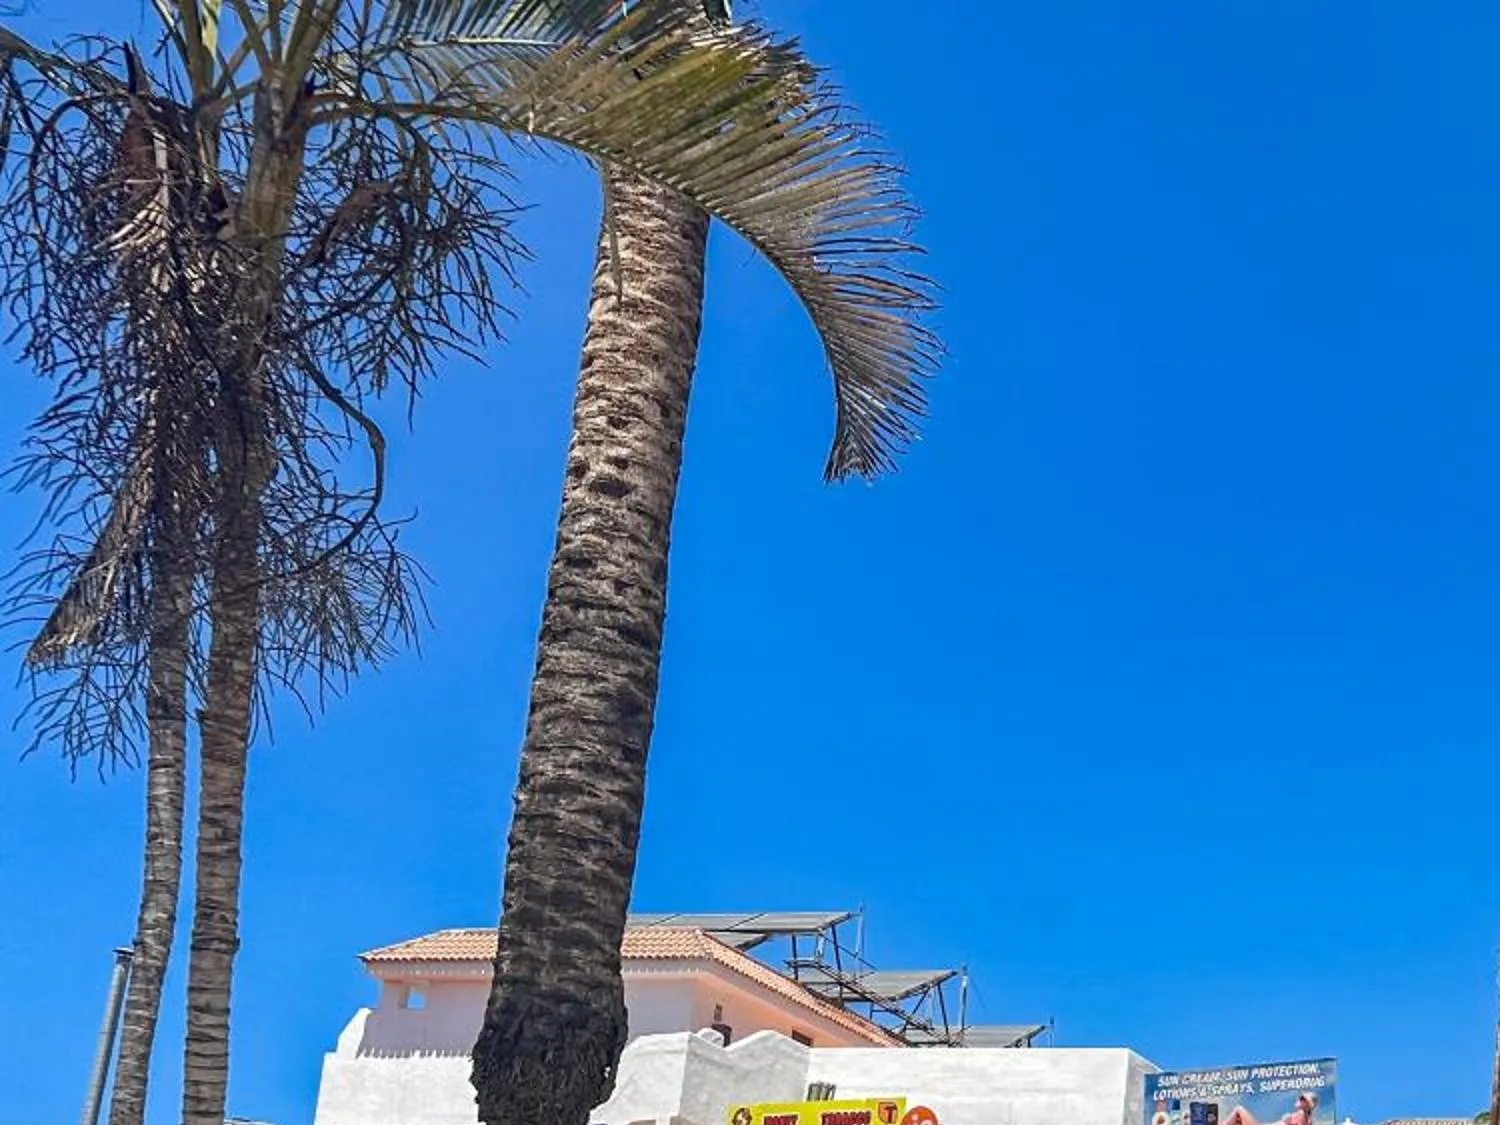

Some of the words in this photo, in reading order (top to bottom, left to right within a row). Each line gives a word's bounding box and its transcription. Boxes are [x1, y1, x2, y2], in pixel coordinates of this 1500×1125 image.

[1153, 1086, 1197, 1101] LOTIONS
[1259, 1075, 1326, 1093] SUPERDRUG
[1157, 1074, 1179, 1087] SUN
[1227, 1068, 1250, 1080] SUN
